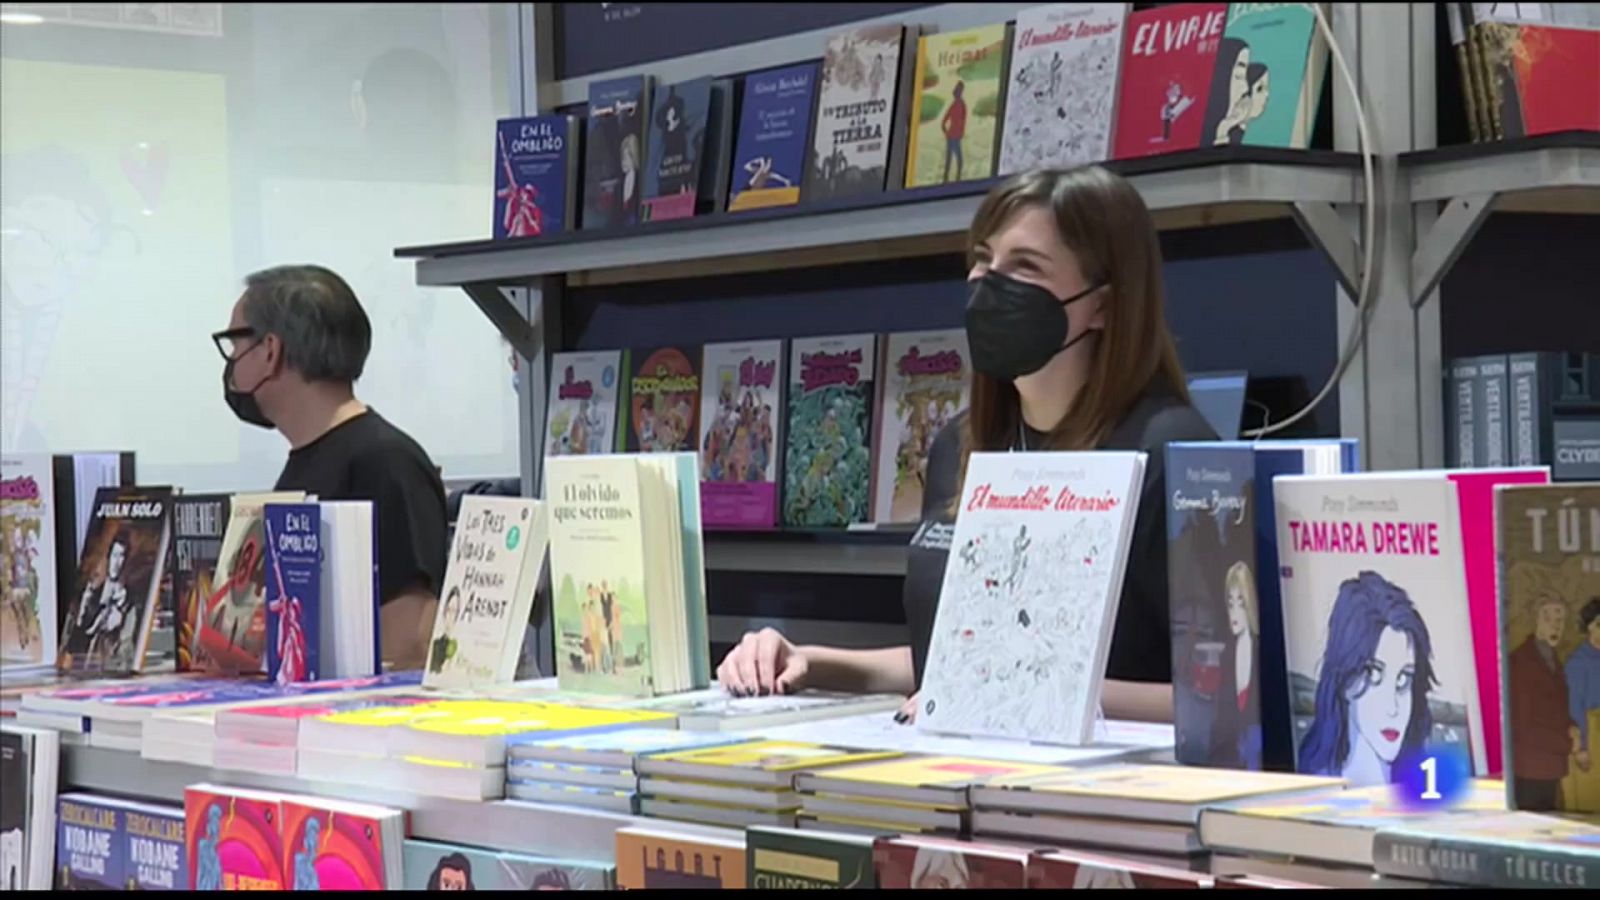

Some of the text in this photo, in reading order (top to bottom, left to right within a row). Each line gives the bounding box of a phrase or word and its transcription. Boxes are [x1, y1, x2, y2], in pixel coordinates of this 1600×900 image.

[1132, 20, 1160, 56] EL
[1164, 11, 1225, 54] VIAJE
[835, 99, 887, 119] TRIBUTO
[521, 124, 539, 138] EN
[832, 124, 882, 144] TIERRA
[511, 136, 563, 153] OMBLIGO
[579, 483, 620, 502] olvido
[967, 484, 1120, 511] El mundillo literario
[97, 502, 162, 518] JUAN SOLO
[554, 506, 577, 524] que
[1289, 521, 1440, 556] TAMARA DREWE
[1504, 852, 1586, 886] TÚNELES
